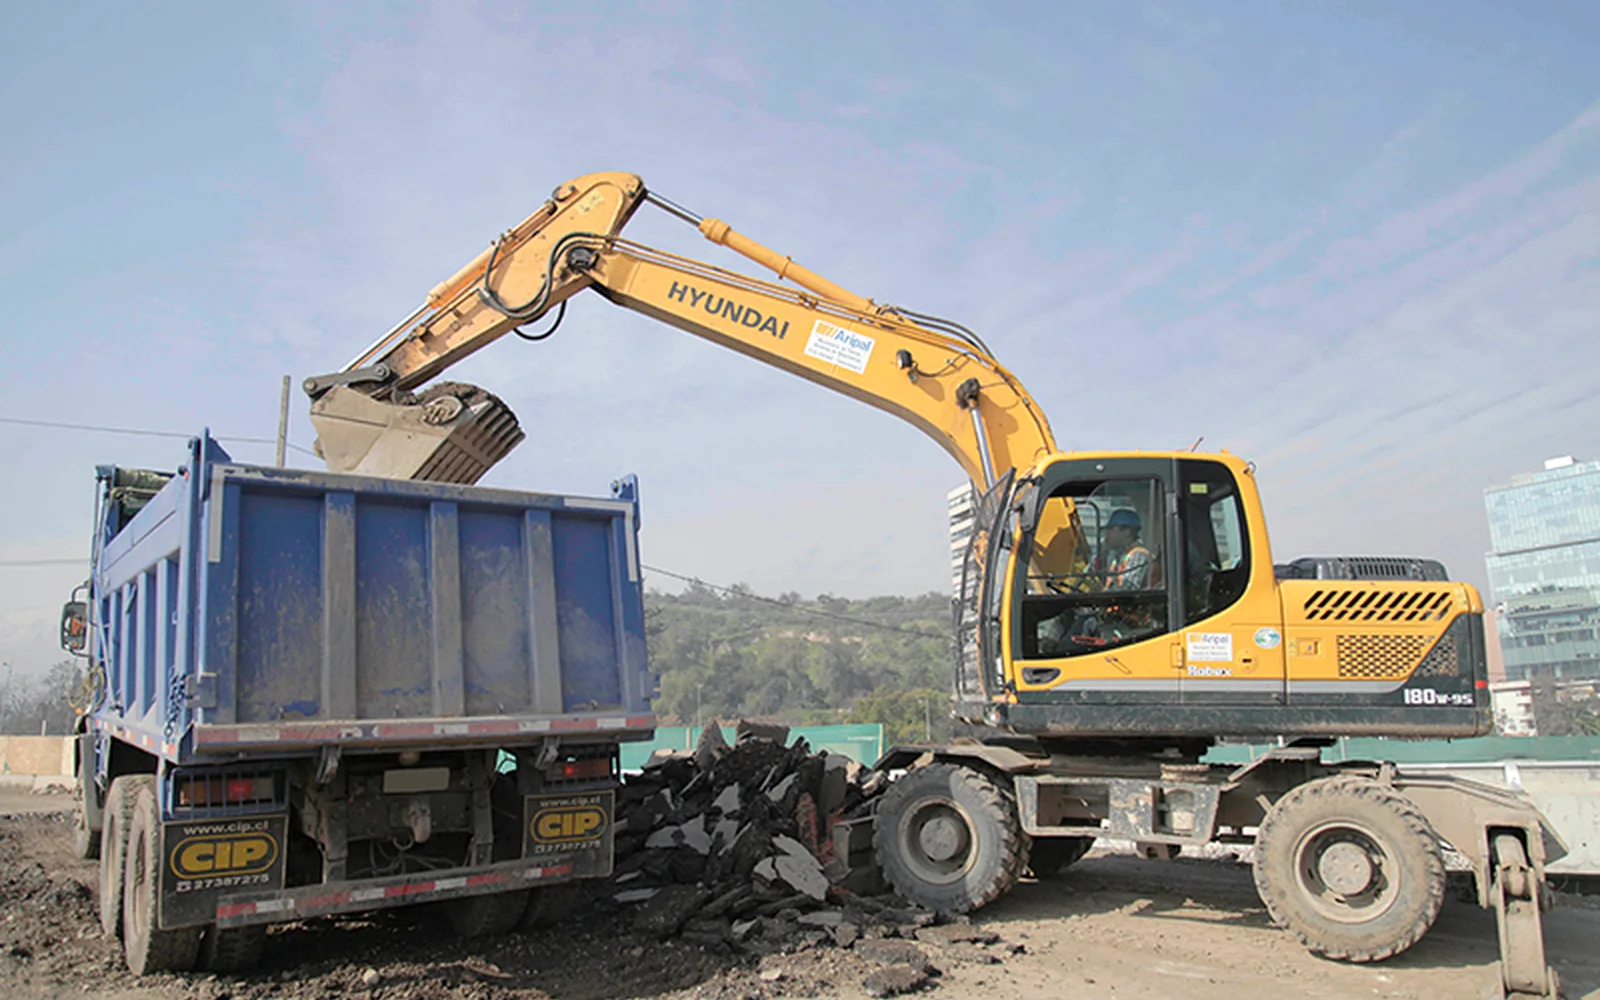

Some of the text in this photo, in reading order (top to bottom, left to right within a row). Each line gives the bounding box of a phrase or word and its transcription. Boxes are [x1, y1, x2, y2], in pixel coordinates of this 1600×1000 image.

[667, 281, 790, 340] HYUNDAI
[834, 330, 873, 352] Aripal
[183, 821, 269, 835] www.cip.cl
[537, 811, 601, 837] CIP
[180, 840, 269, 872] CIP
